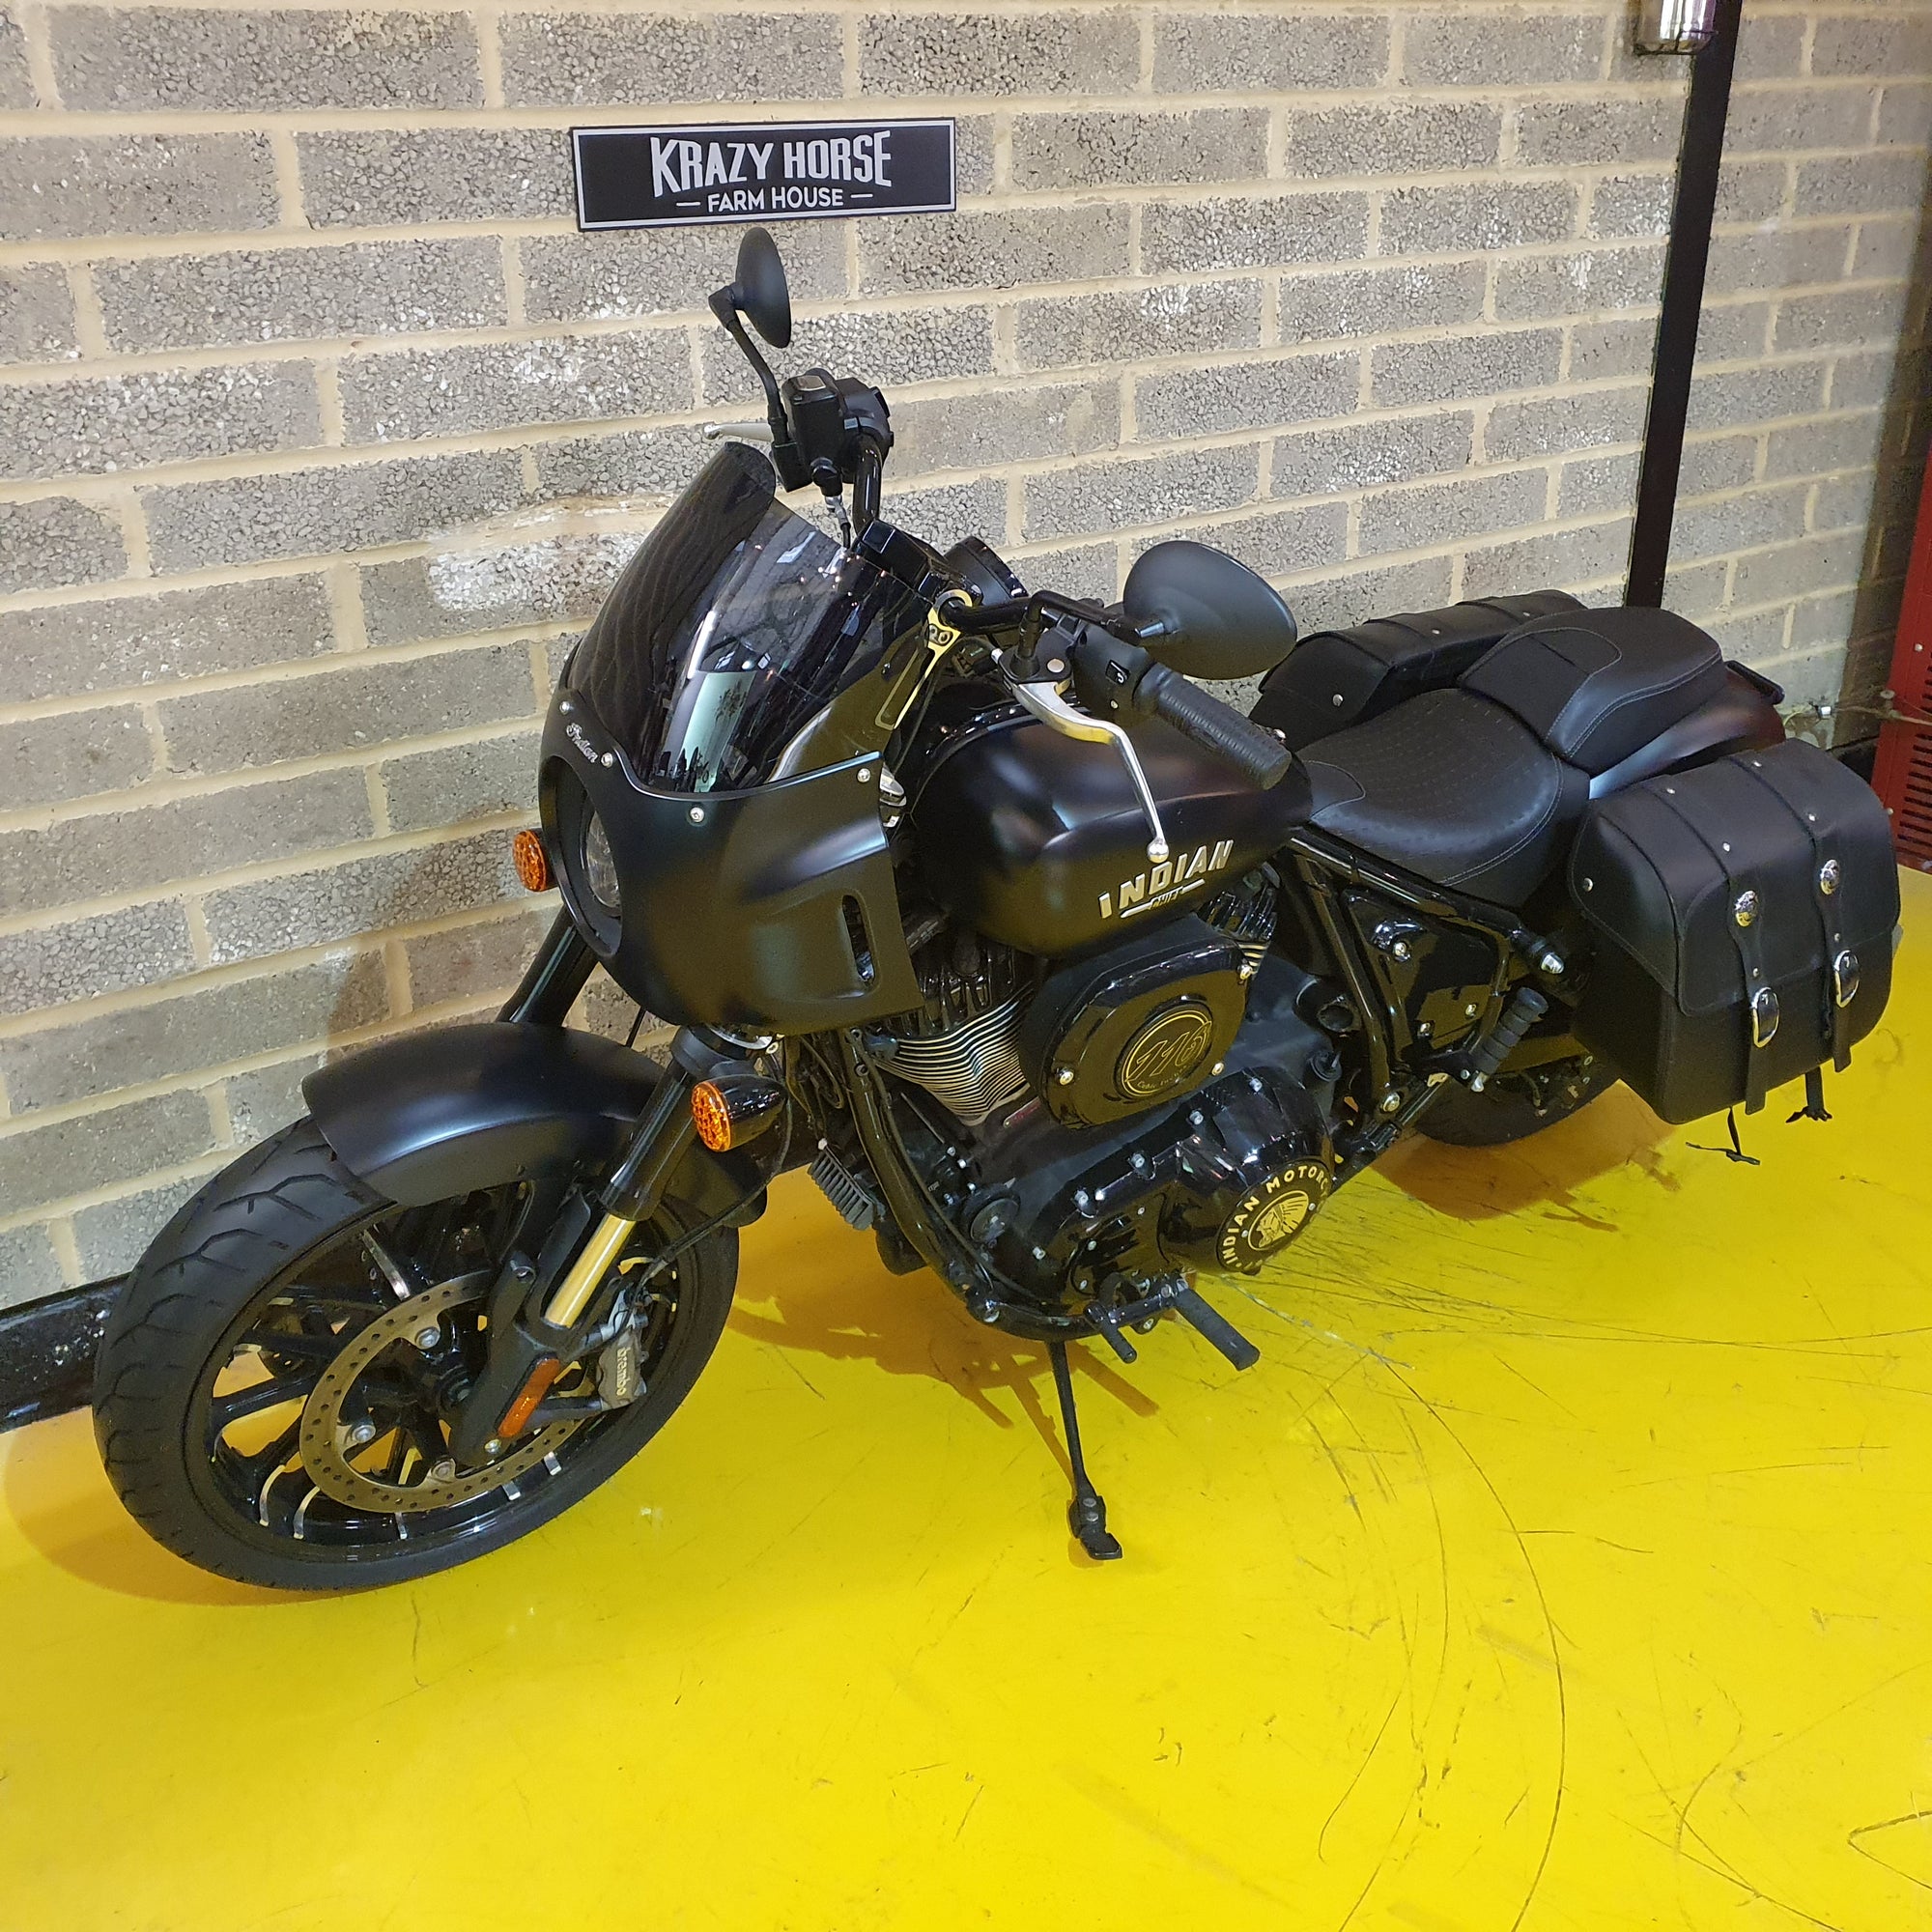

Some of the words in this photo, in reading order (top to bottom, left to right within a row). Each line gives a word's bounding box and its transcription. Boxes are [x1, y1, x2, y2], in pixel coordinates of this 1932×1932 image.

[649, 136, 775, 198] KRAZY
[783, 129, 893, 187] HORSE
[707, 188, 765, 213] FARM
[771, 185, 844, 209] HOUSE
[1097, 838, 1235, 920] INDIAN
[1123, 1020, 1212, 1083] 116
[1221, 1195, 1261, 1265] INDIAN
[1265, 1164, 1329, 1198] MOTORC
[616, 1347, 632, 1397] brembo
